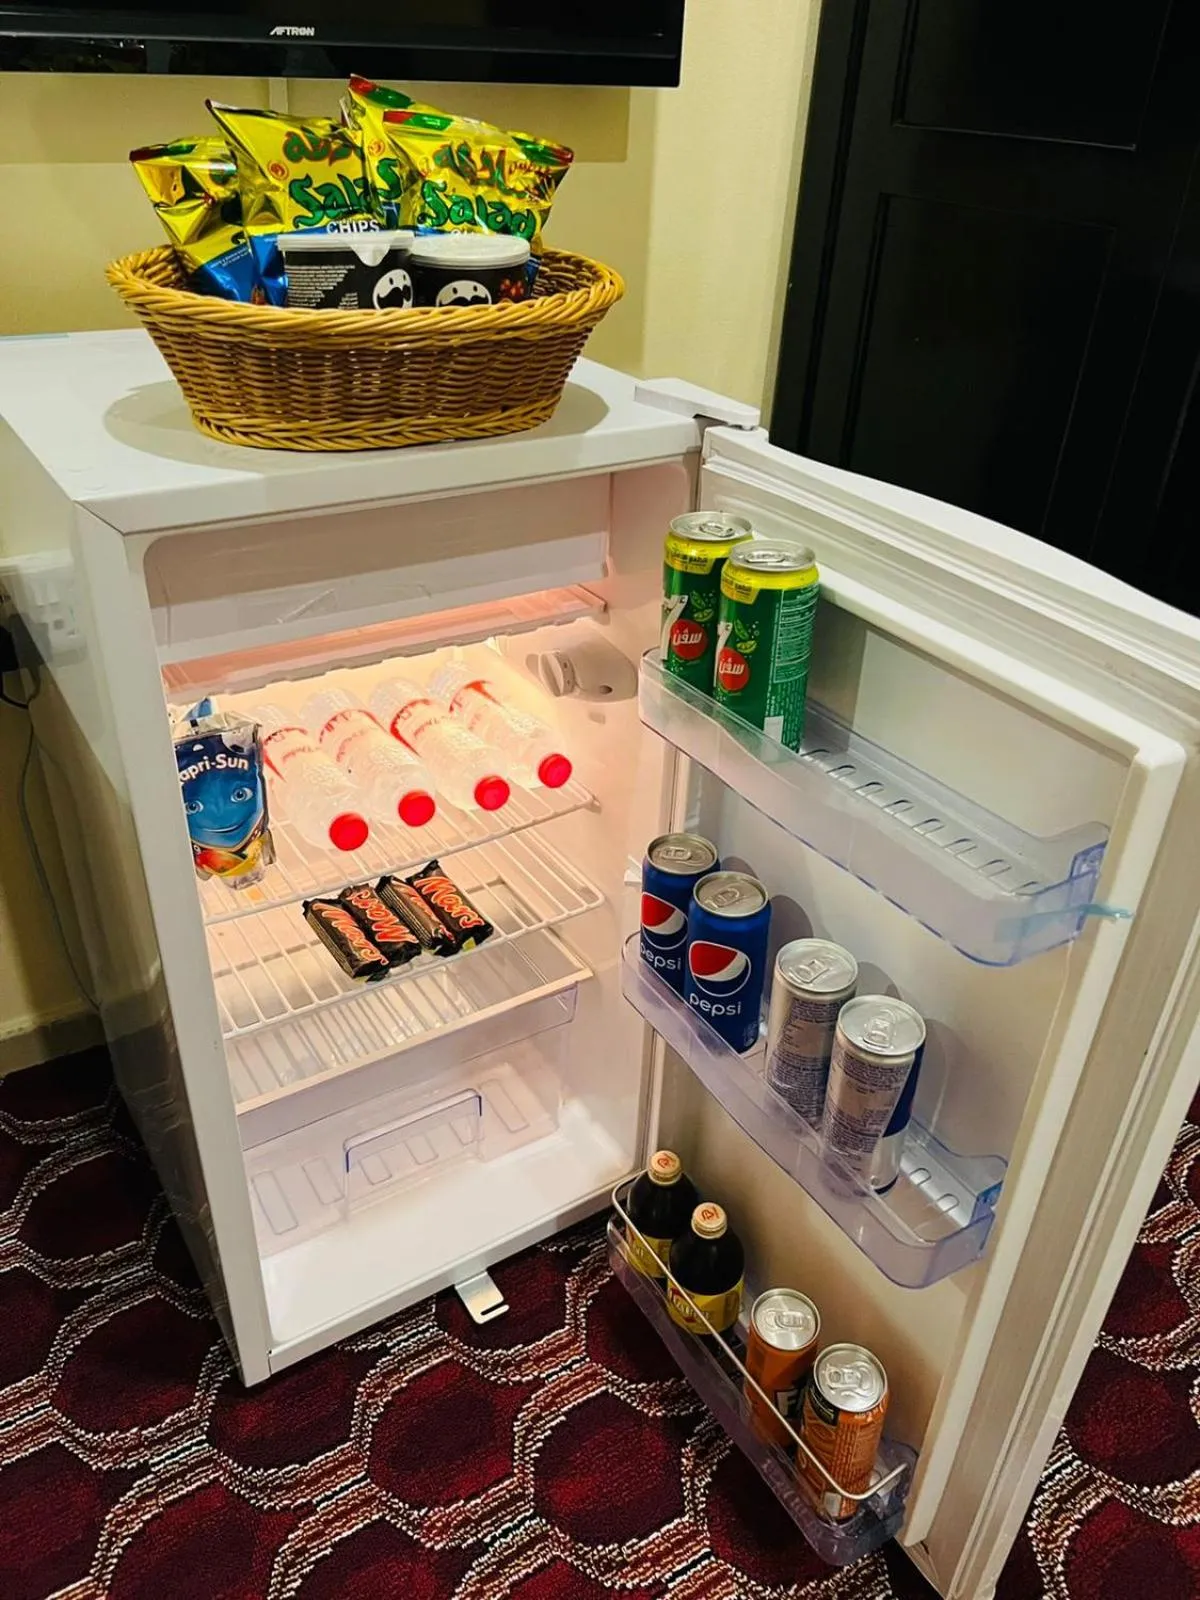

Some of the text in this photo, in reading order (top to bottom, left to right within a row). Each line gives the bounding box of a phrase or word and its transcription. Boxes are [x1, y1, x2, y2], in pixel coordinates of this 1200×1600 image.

[269, 26, 315, 36] AFTRON
[416, 178, 537, 242] Salad
[326, 219, 380, 235] CHIPS
[178, 752, 251, 783] apri-Sun
[413, 875, 486, 929] Mars
[689, 992, 742, 1017] pepsi
